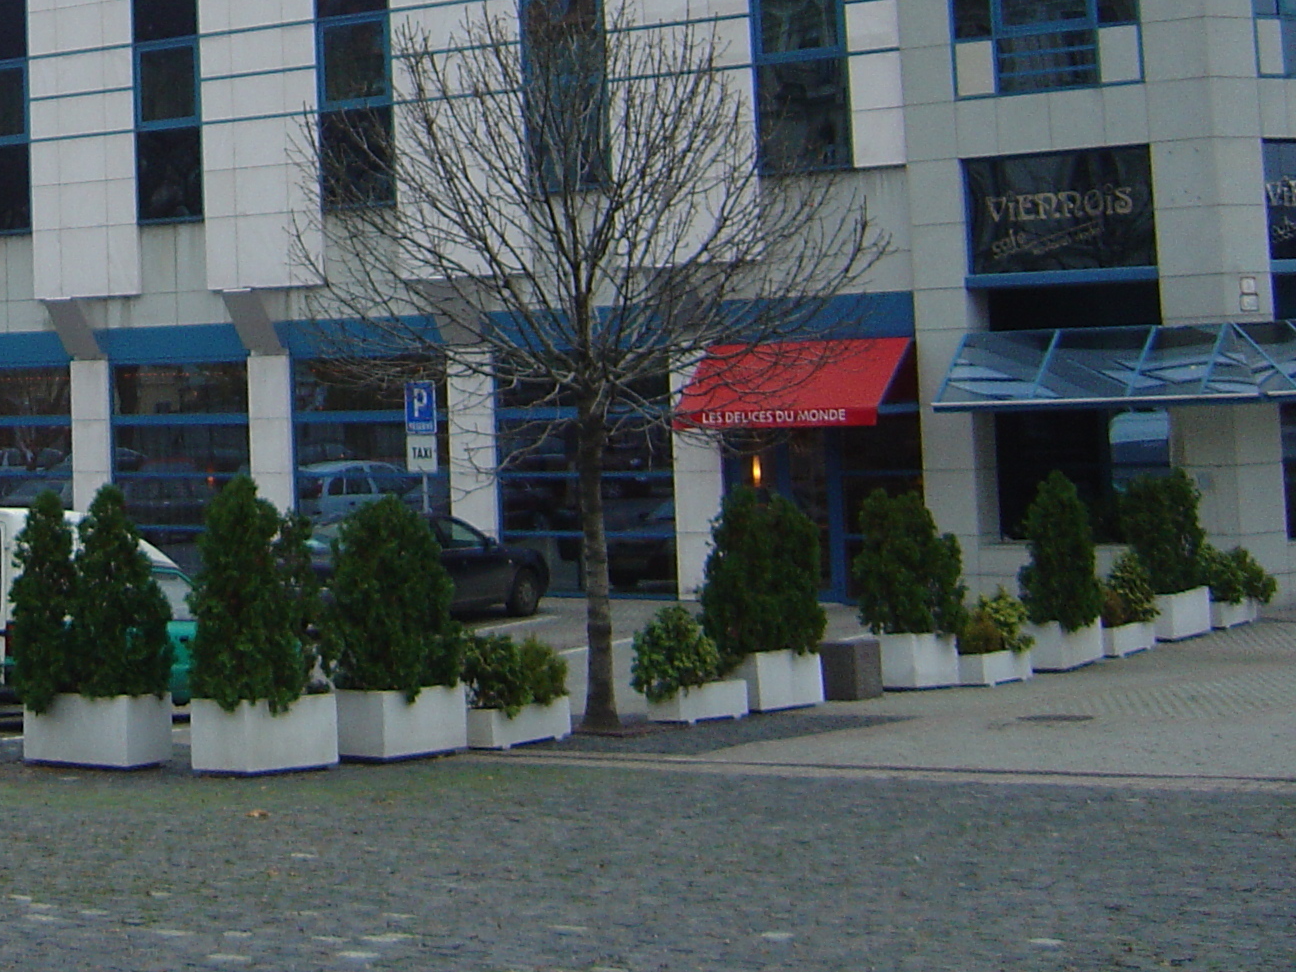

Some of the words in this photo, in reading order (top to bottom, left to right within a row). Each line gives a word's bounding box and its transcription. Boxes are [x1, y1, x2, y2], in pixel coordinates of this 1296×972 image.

[413, 388, 428, 418] P
[702, 412, 722, 424] LES
[725, 410, 773, 423] DELICES
[775, 410, 794, 422] DU
[797, 408, 846, 421] MONDE
[412, 446, 433, 459] TAXI
